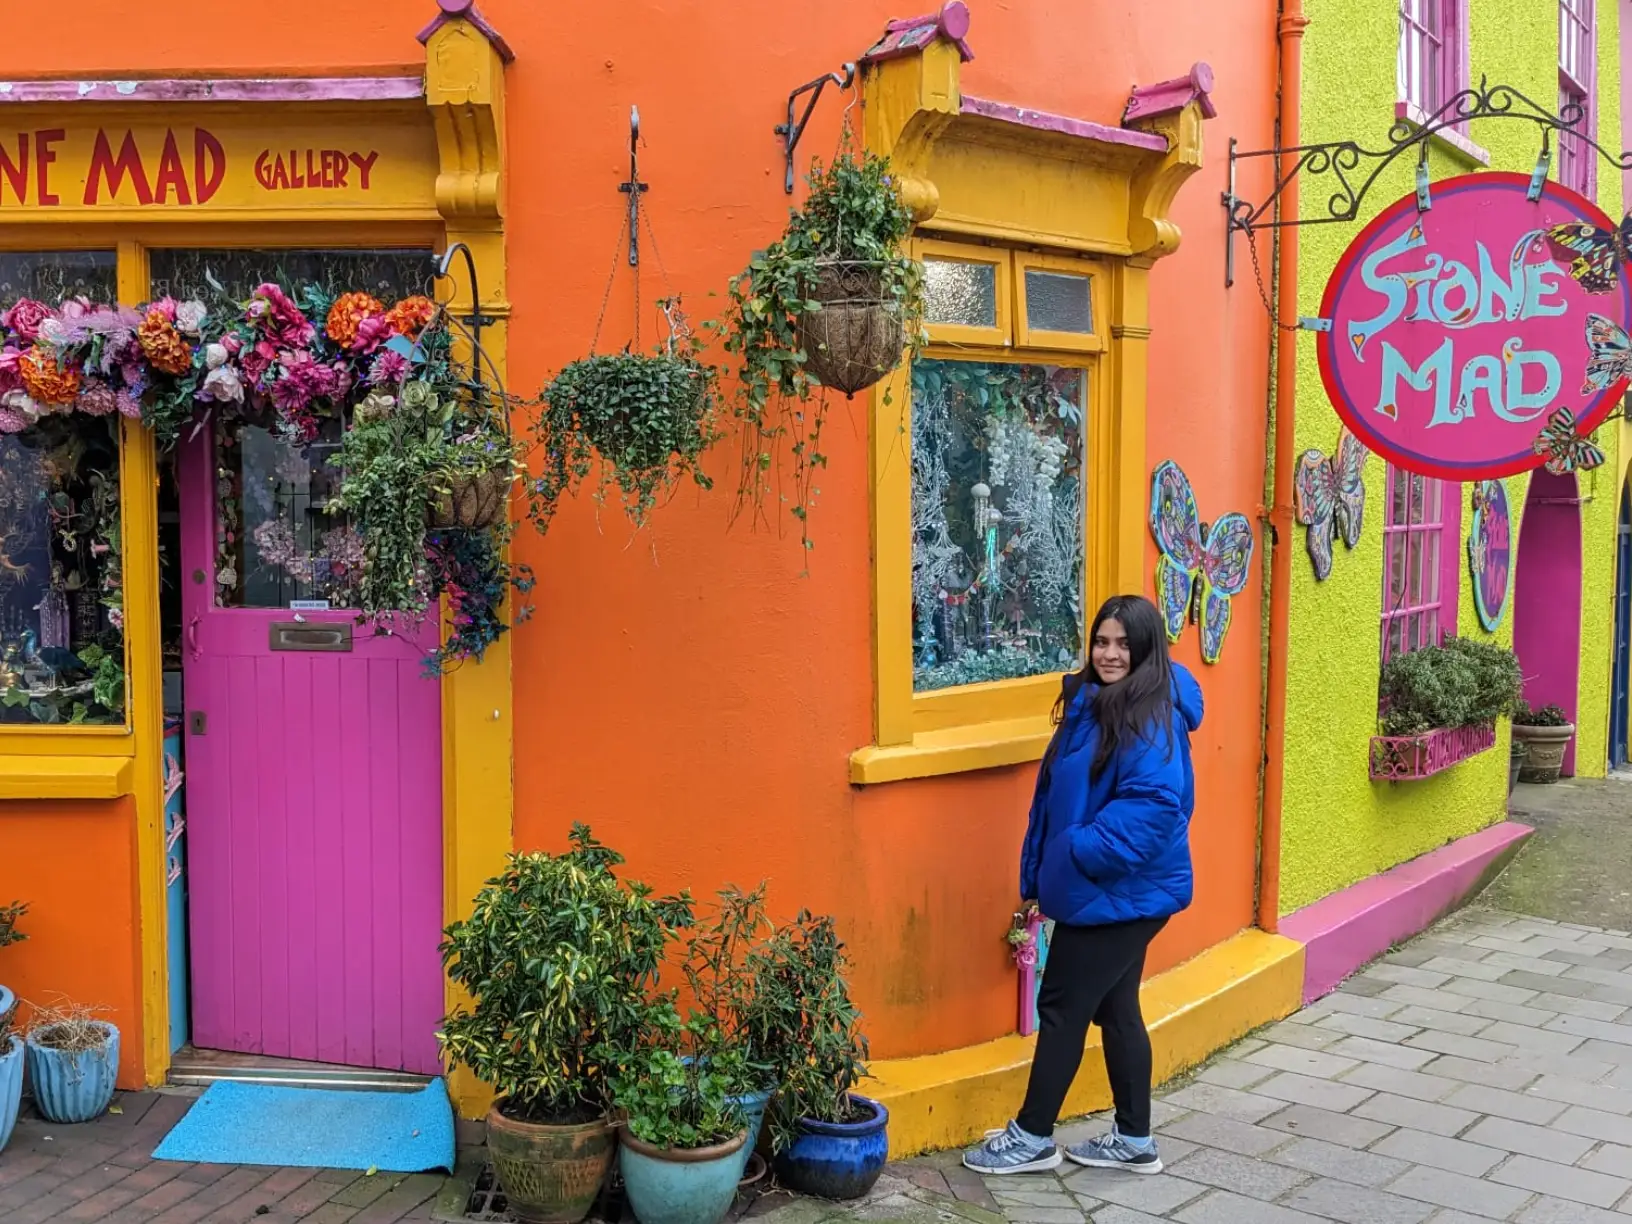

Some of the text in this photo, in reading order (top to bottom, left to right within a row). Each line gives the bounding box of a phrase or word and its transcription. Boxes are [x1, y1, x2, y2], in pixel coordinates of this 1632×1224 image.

[83, 127, 226, 205] MAD
[254, 149, 379, 190] GALLERY
[1348, 216, 1568, 362] STONE
[1373, 336, 1562, 429] MAD
